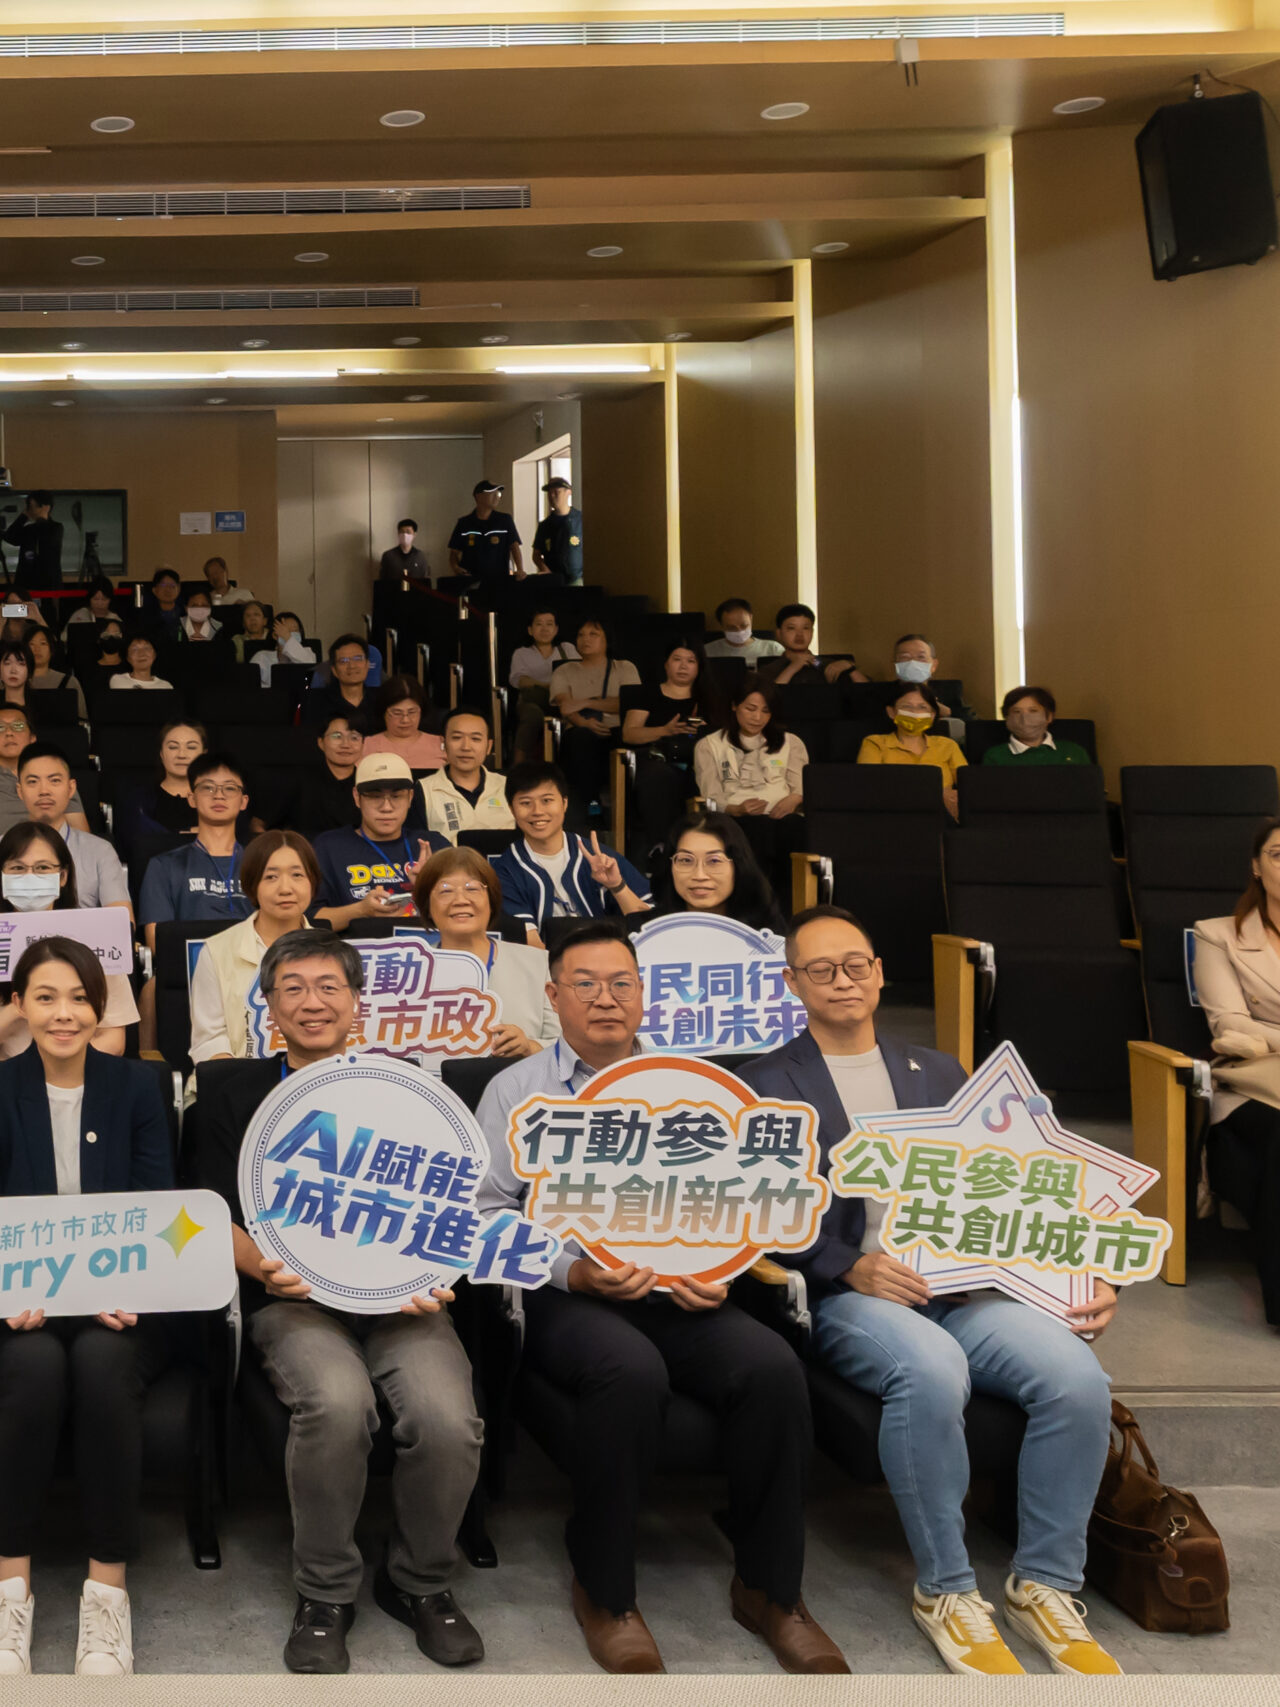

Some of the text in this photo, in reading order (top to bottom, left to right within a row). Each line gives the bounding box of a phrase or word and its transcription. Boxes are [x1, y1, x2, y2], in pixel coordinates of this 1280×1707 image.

[638, 960, 788, 1006] 民同行
[263, 1109, 483, 1205] AI賦能
[522, 1107, 804, 1169] 行動參與
[541, 1173, 816, 1237] 共創新竹
[839, 1137, 1080, 1211] 公民參與
[0, 1206, 149, 1251] 新竹市政府
[257, 1167, 552, 1285] 城市進化
[894, 1196, 1164, 1276] 共創城市
[88, 1241, 148, 1280] on
